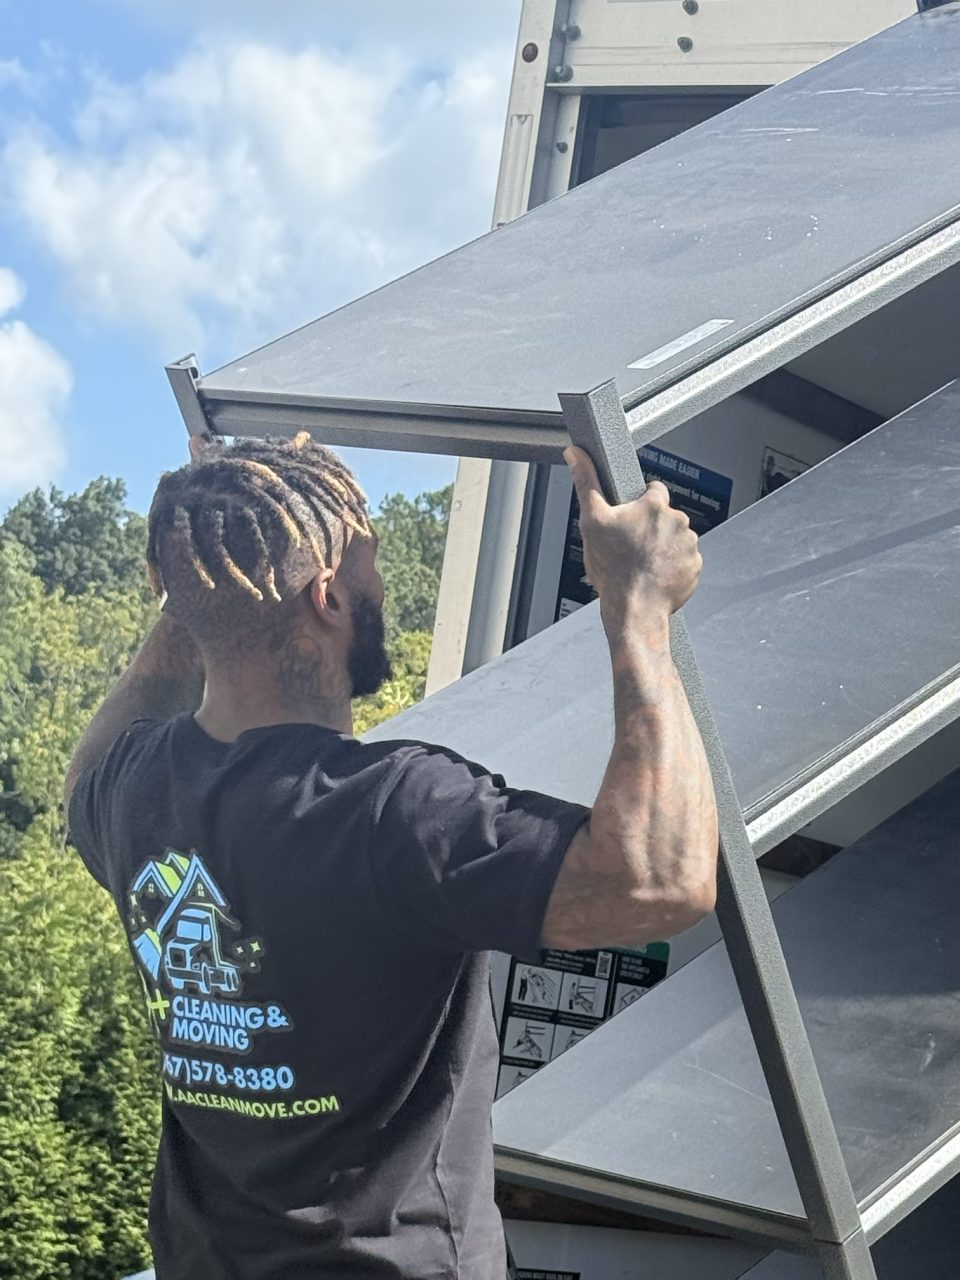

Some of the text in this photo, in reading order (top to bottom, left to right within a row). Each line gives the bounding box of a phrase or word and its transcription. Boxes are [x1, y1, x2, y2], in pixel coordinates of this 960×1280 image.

[172, 996, 289, 1029] CLEANING &
[172, 1018, 249, 1050] MOVING
